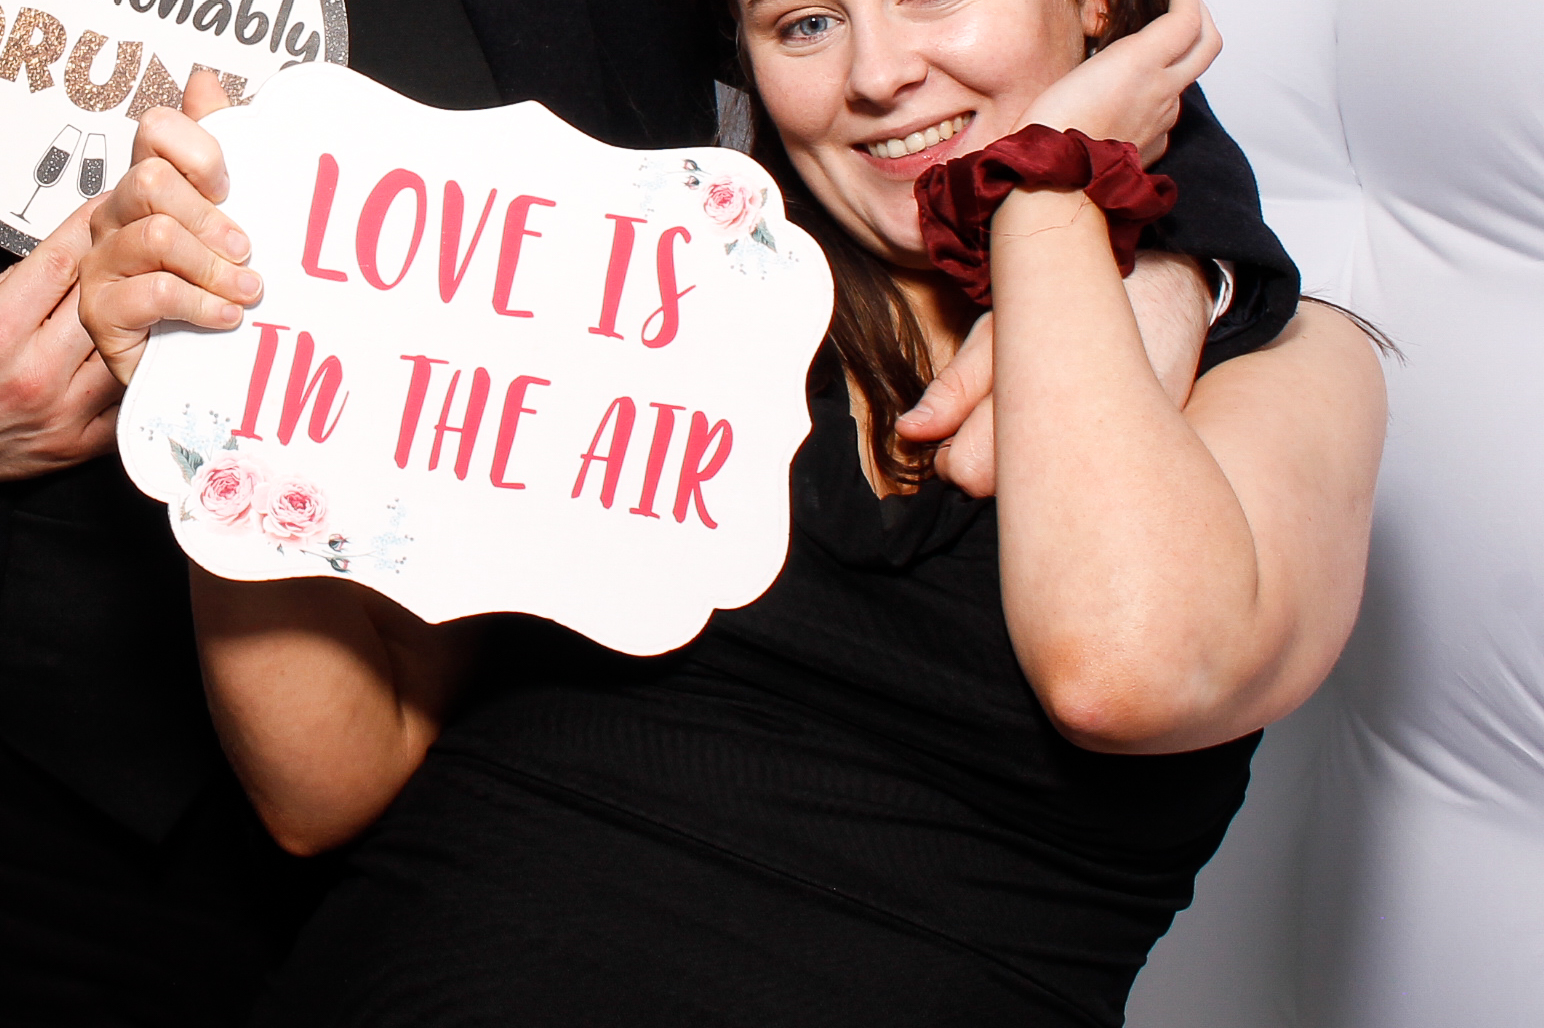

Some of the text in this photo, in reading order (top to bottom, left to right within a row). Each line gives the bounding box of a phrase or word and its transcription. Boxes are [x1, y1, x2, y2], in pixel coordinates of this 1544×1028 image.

[300, 152, 697, 350] LOVE IS
[393, 353, 552, 491] THE
[570, 395, 734, 531] AIR
